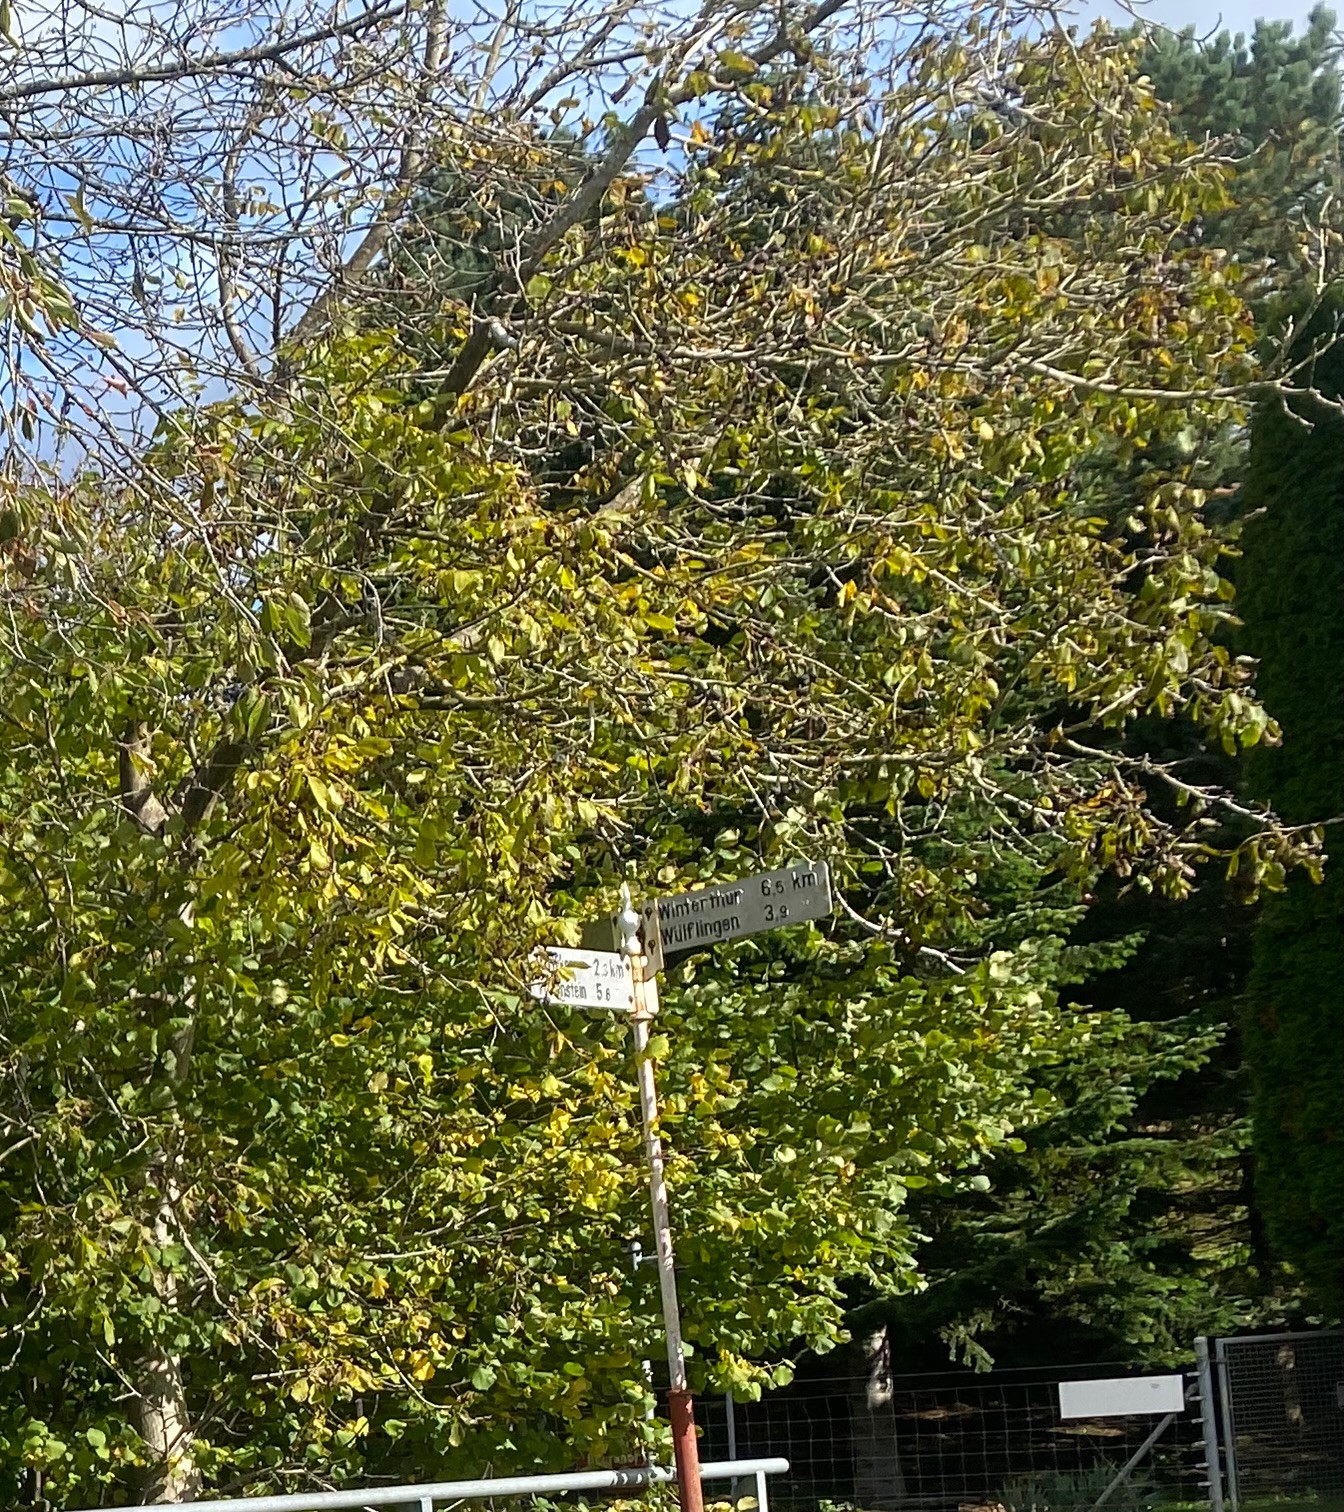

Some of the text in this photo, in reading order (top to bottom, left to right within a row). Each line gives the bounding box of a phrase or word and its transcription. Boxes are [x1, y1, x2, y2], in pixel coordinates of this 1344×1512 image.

[658, 888, 745, 920] Winterthur
[791, 871, 818, 891] km
[660, 916, 740, 945] Wülflingen
